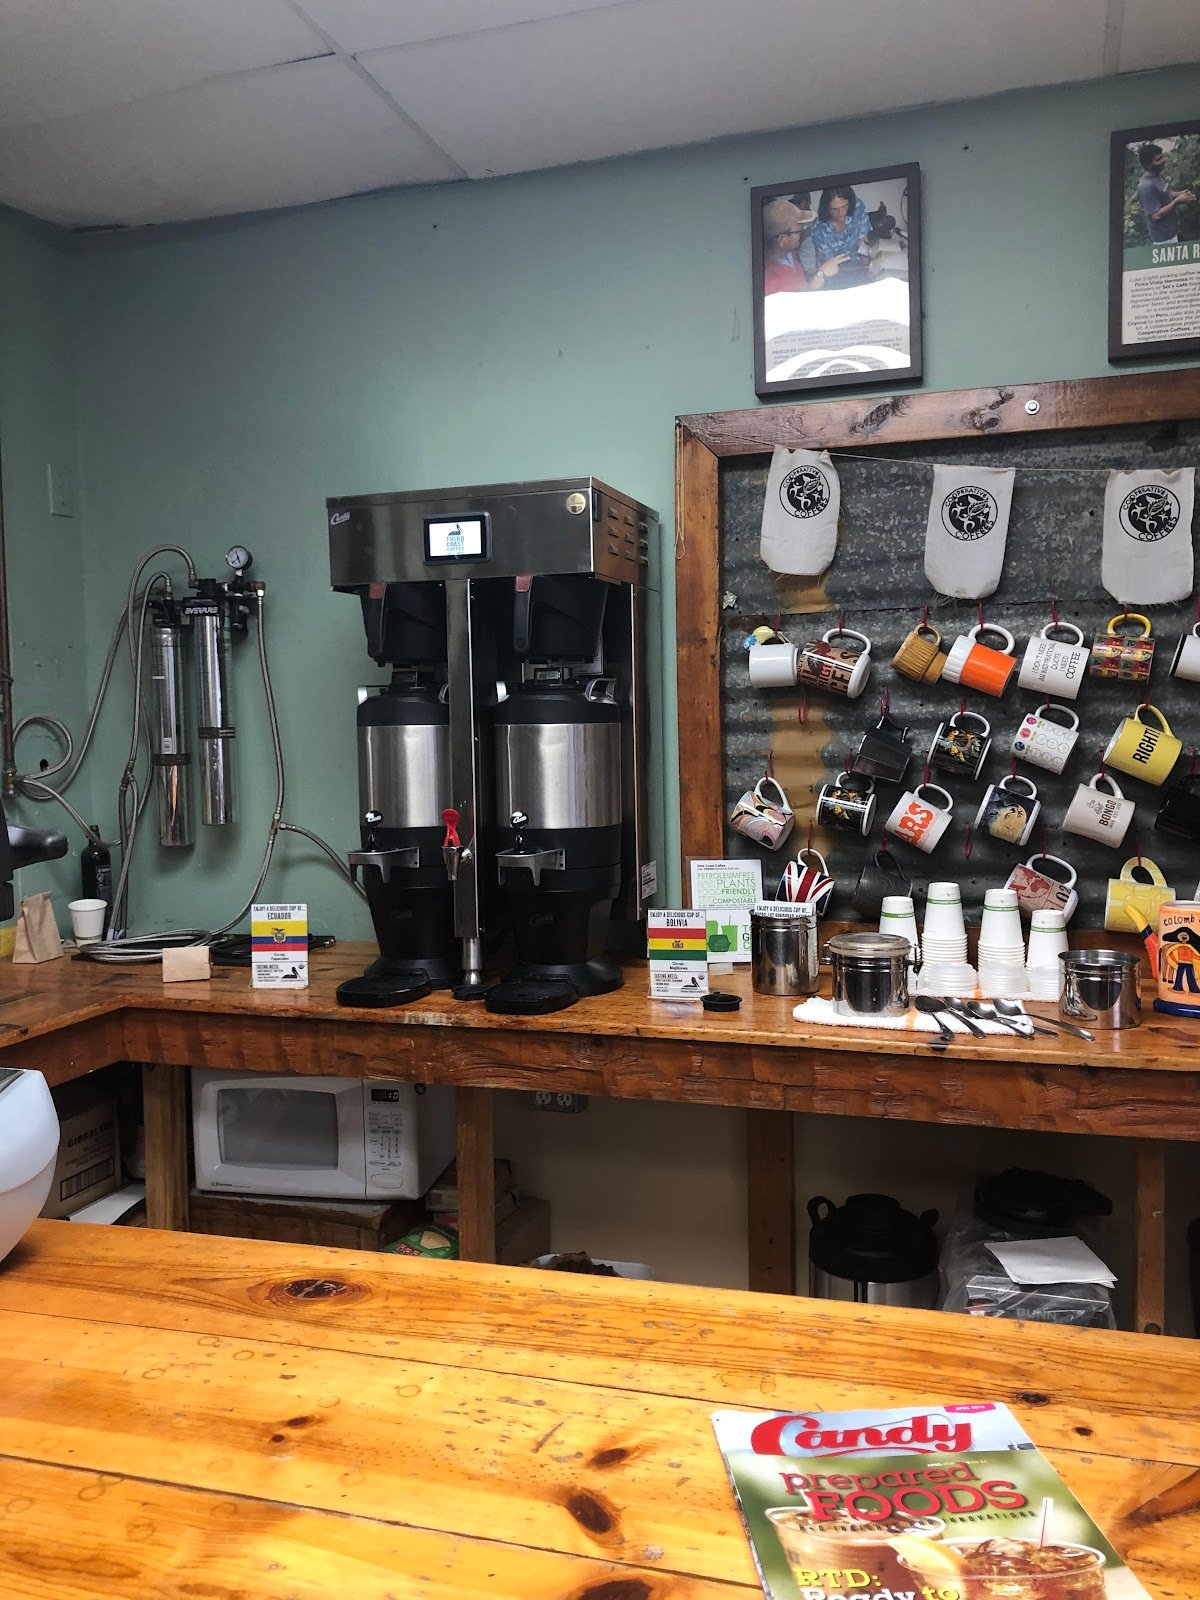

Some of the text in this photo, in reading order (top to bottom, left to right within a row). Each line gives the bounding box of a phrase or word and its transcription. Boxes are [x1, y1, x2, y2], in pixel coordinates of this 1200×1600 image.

[1152, 245, 1189, 264] SANTA
[185, 606, 219, 615] EVERPURE
[1066, 652, 1081, 679] COFFEE
[1098, 800, 1117, 827] BONGO
[716, 879, 756, 888] PLANTS
[268, 912, 292, 920] ECUADOR
[666, 919, 688, 927] BOLIVIA
[750, 1416, 973, 1457] Candy
[778, 1462, 980, 1495] prepared
[804, 1480, 1028, 1522] FOODS
[942, 1510, 1037, 1523] INNOVATIONS
[792, 1568, 883, 1589] RTD:
[922, 1586, 960, 1600] to
